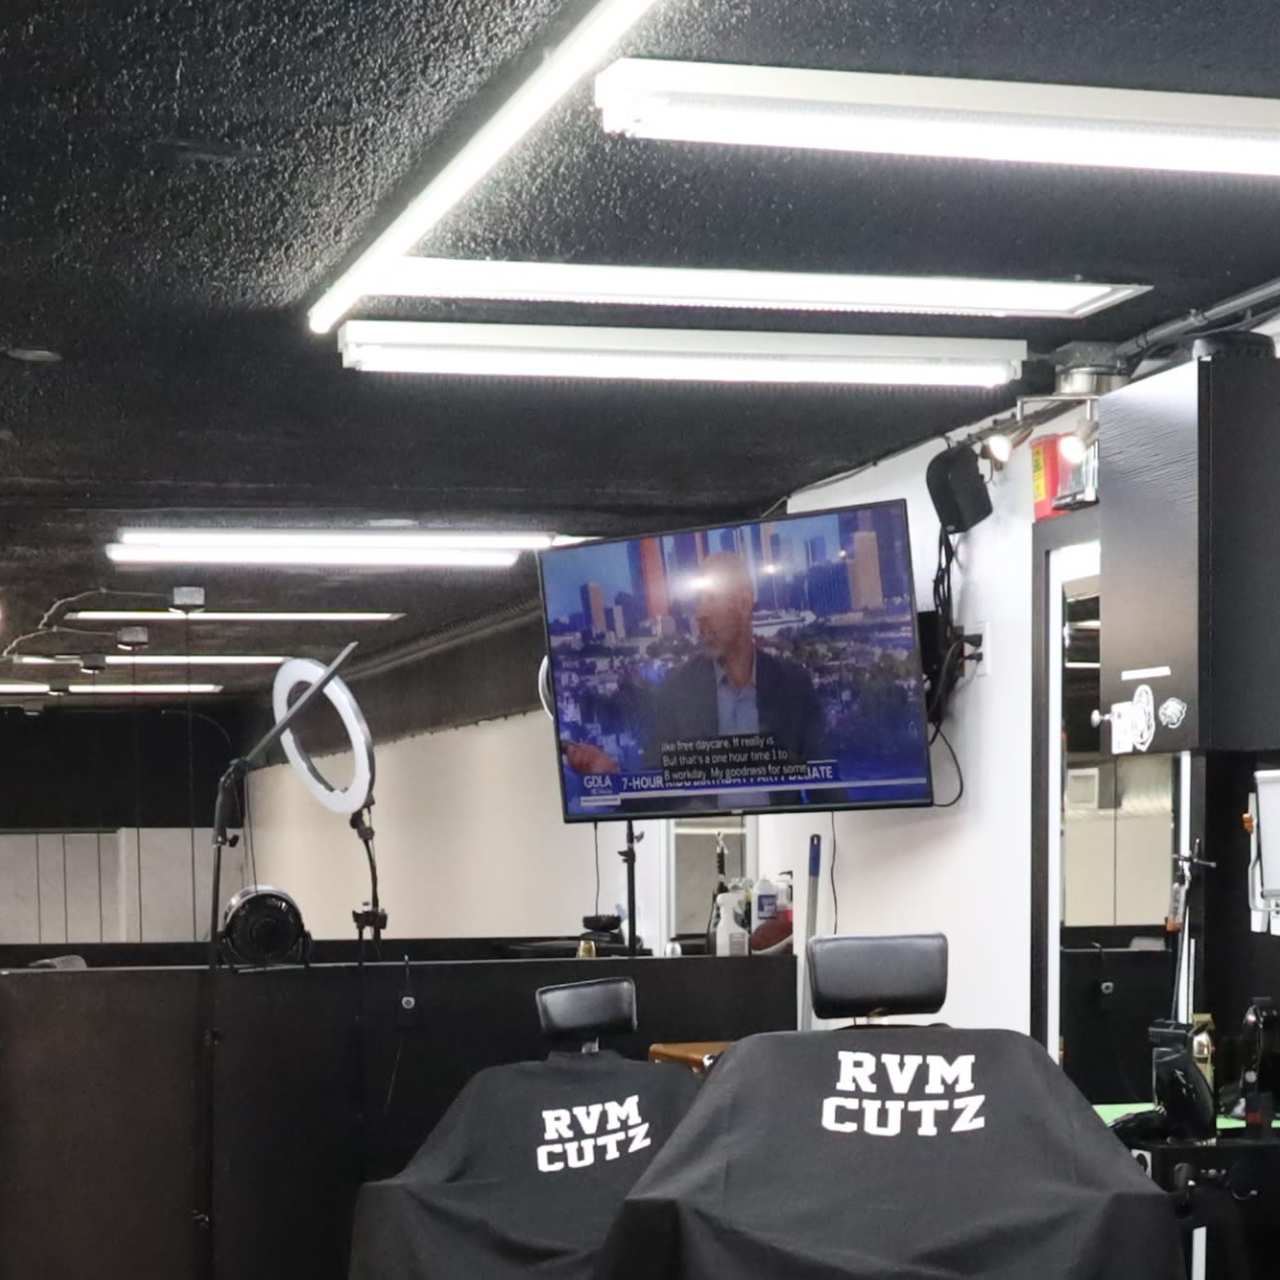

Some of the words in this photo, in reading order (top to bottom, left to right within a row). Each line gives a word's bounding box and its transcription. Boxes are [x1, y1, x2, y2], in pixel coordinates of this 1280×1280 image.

[622, 775, 664, 790] 7-HOUR
[836, 1051, 975, 1094] RVM
[542, 1095, 641, 1140] RVM
[822, 1095, 985, 1136] CUTZ
[537, 1123, 651, 1172] CUTZ
